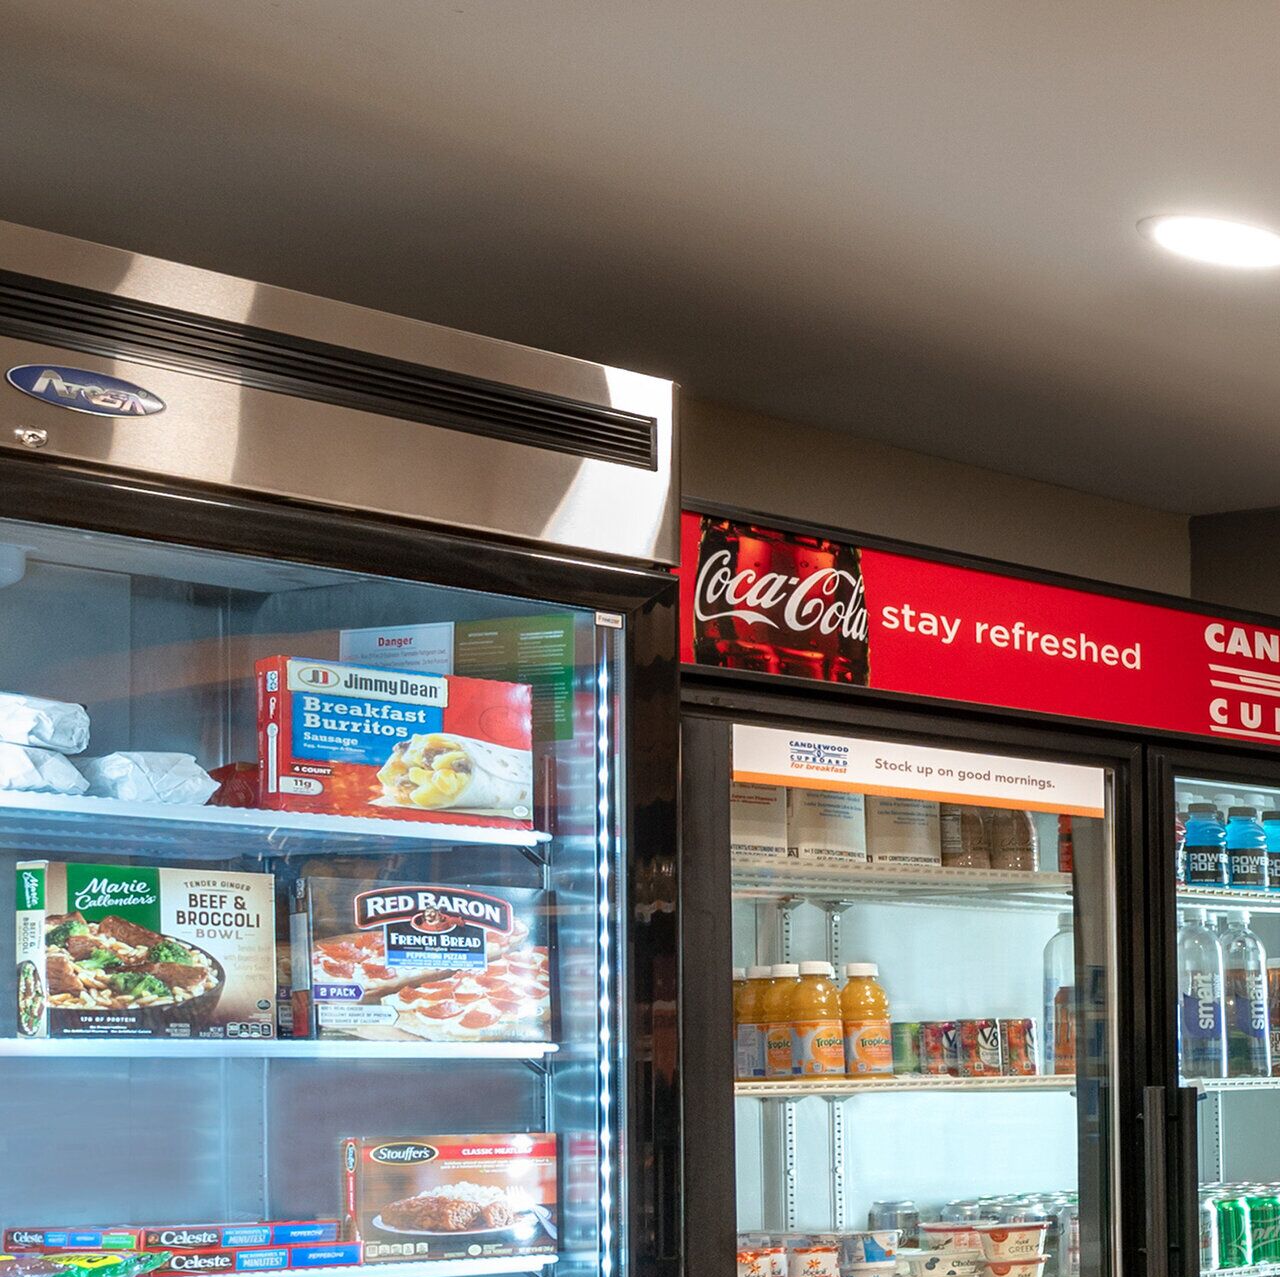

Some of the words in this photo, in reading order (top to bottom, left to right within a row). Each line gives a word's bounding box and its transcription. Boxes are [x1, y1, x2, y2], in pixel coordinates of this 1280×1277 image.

[695, 549, 870, 641] Coca-Cola
[378, 636, 413, 648] Danger
[882, 603, 961, 644] stay
[975, 622, 1142, 670] refreshed
[344, 673, 398, 695] Jimmy
[400, 679, 438, 699] Dean
[303, 696, 427, 723] Breakfast
[303, 713, 408, 737] Burritos
[303, 732, 359, 746] Sausage
[789, 740, 850, 753] CANDLEWOOD
[789, 754, 849, 767] CUPBOARD
[789, 762, 804, 770] for
[805, 762, 848, 773] breakfast
[301, 766, 332, 775] COUNT
[875, 757, 913, 773] Stock
[920, 763, 934, 778] up
[937, 767, 954, 777] on
[958, 767, 992, 783] good
[995, 773, 1056, 791] mornings.
[75, 878, 150, 896] Marie
[184, 880, 218, 889] TENDER
[220, 881, 252, 891] GINGER
[75, 894, 156, 910] Callender's
[188, 893, 229, 909] BEEF
[234, 896, 248, 910] &
[366, 895, 415, 918] RED
[417, 892, 501, 924] BARON
[176, 910, 261, 928] BROCCOLI
[196, 929, 244, 940] BOWL
[390, 932, 437, 946] FRENCH
[440, 934, 482, 947] BREAD
[320, 987, 327, 996] 2
[330, 987, 357, 997] PACK
[1198, 973, 1215, 1030] smart
[377, 1147, 430, 1161] Stouffer's
[13, 1231, 45, 1244] Celeste
[160, 1229, 218, 1246] Celeste
[171, 1253, 232, 1270] Celeste
